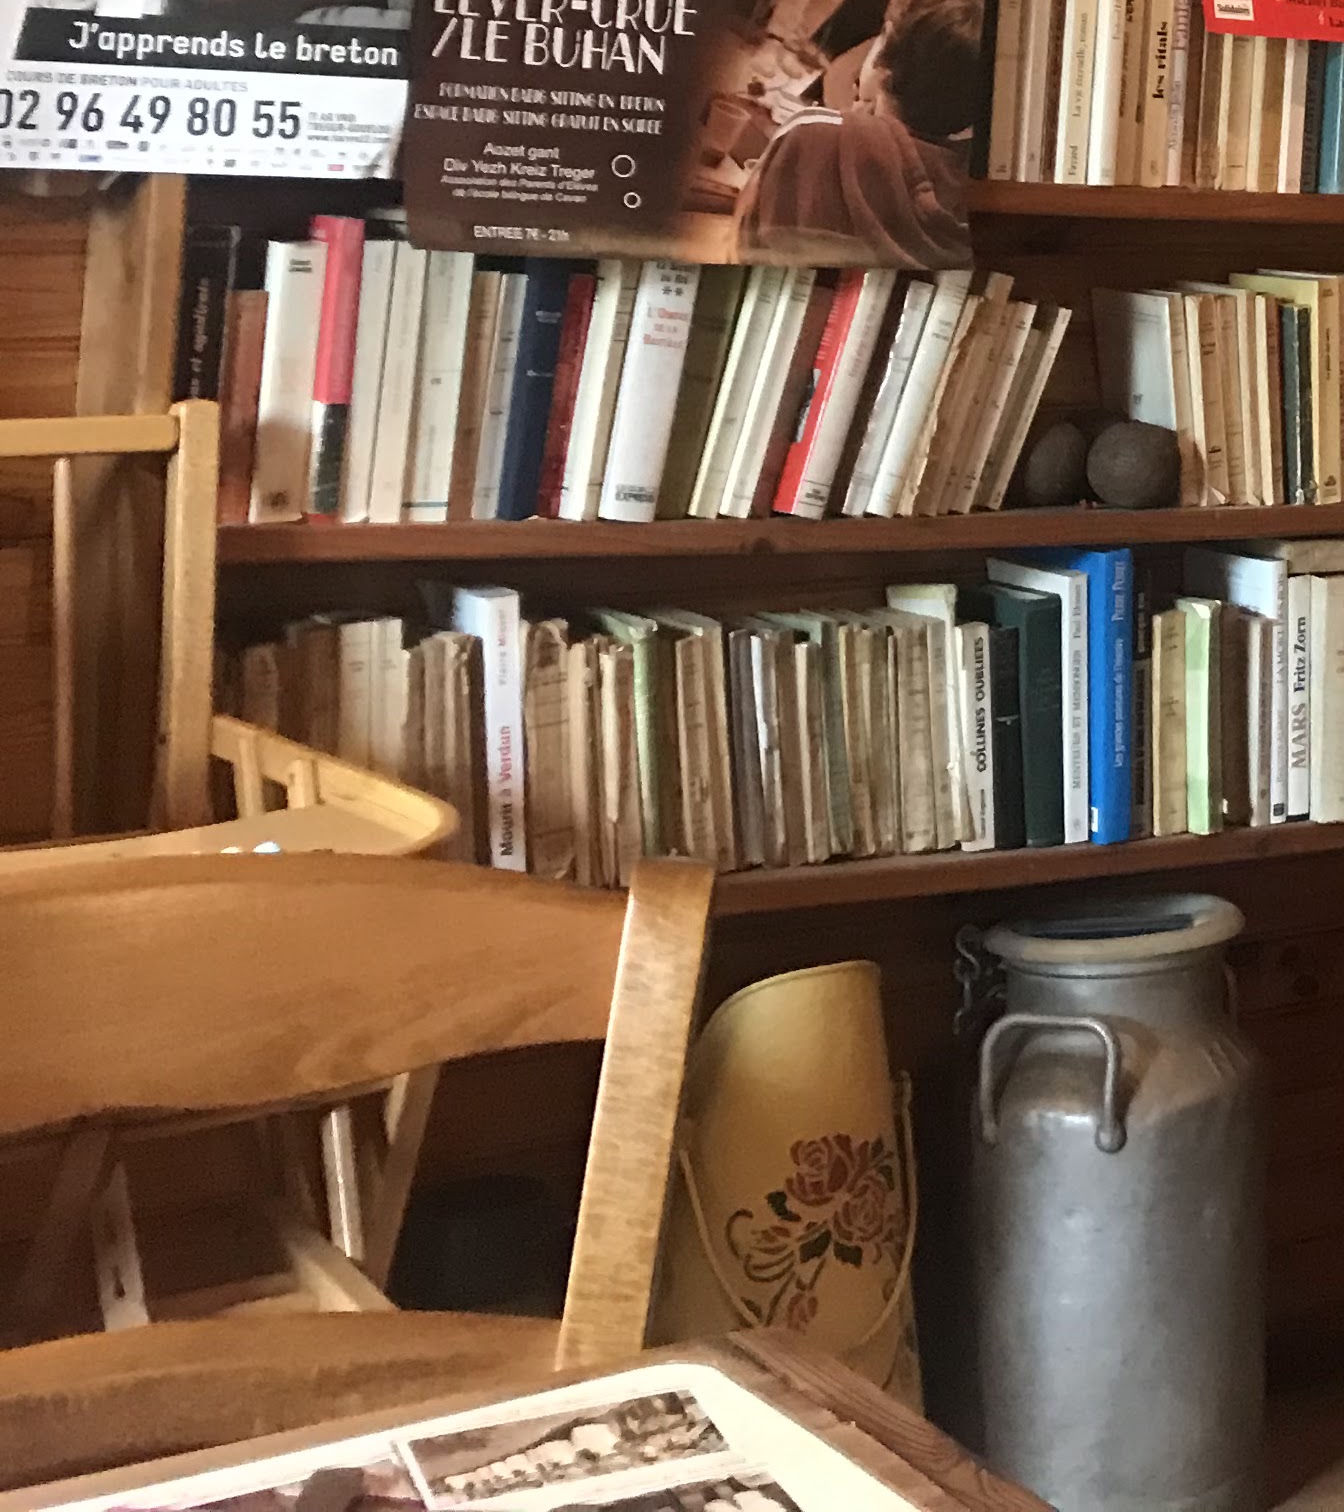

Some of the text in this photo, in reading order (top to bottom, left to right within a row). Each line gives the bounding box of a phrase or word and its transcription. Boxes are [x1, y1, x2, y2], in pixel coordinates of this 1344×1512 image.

[68, 20, 399, 66] J'apprends le breton
[523, 24, 667, 75] BUHAN
[56, 90, 104, 133] 96
[119, 94, 172, 134] 49
[186, 97, 237, 137] 80
[252, 99, 302, 139] 55
[551, 163, 595, 180] Treger
[1291, 616, 1307, 768] MARS Fritz Zorn
[498, 726, 513, 781] Verdun
[975, 707, 987, 773] COLLINES
